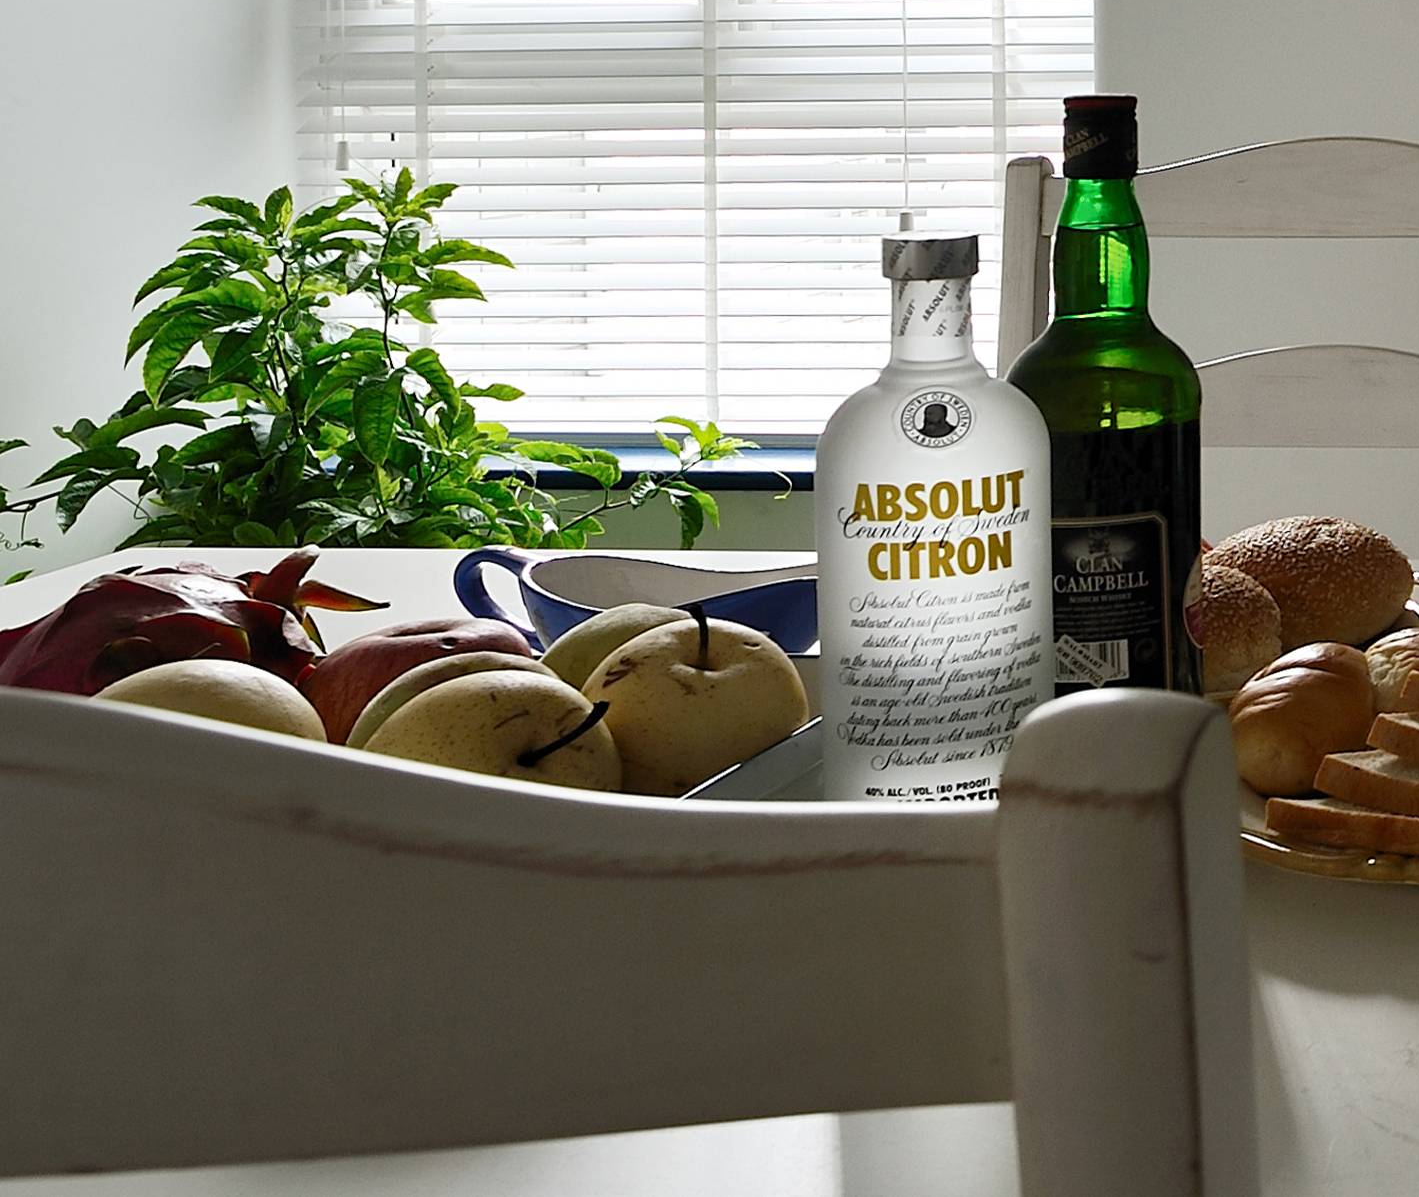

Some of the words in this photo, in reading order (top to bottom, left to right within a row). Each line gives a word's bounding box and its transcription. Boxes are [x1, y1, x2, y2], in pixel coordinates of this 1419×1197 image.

[853, 469, 1024, 522] ABSOLUT
[837, 506, 924, 551] Country
[932, 516, 953, 548] of
[958, 504, 1031, 537] Sweden
[868, 530, 1012, 581] CITRON
[1076, 552, 1124, 575] CLAN
[849, 590, 914, 613] Absolut
[916, 590, 957, 608] Citron
[960, 593, 973, 603] is
[975, 583, 1006, 601] made
[1006, 579, 1031, 602] from
[1053, 570, 1149, 594] CAMPBELL
[849, 615, 895, 628] natural
[894, 616, 931, 629] citrus
[977, 603, 1002, 621] and
[1003, 598, 1033, 616] vodka
[862, 634, 910, 649] distilled
[911, 634, 944, 654] from
[943, 632, 981, 657] grain
[980, 624, 1018, 653] grown
[839, 666, 860, 686] The
[861, 674, 915, 696] distilling
[916, 672, 946, 687] and
[941, 667, 1002, 697] flavoring
[1002, 656, 1017, 680] of
[1016, 651, 1041, 671] vodka
[851, 653, 867, 667] the
[872, 654, 893, 668] rich
[892, 653, 928, 674] fields
[930, 654, 946, 672] of
[947, 647, 1002, 664] southern
[851, 695, 861, 706] is
[861, 698, 878, 707] an
[928, 684, 986, 708] Swedish
[987, 676, 1032, 697] tradition
[837, 723, 876, 746] Vodka
[876, 733, 900, 747] has
[901, 733, 930, 747] been
[933, 727, 965, 745] sold
[965, 722, 1001, 740] under
[847, 711, 881, 735] dating
[882, 711, 912, 726] back
[914, 715, 945, 727] more
[948, 708, 978, 723] than
[871, 748, 939, 771] Absolut
[942, 750, 976, 764] since
[980, 734, 1014, 757] 1879
[956, 777, 991, 791] PROOF)
